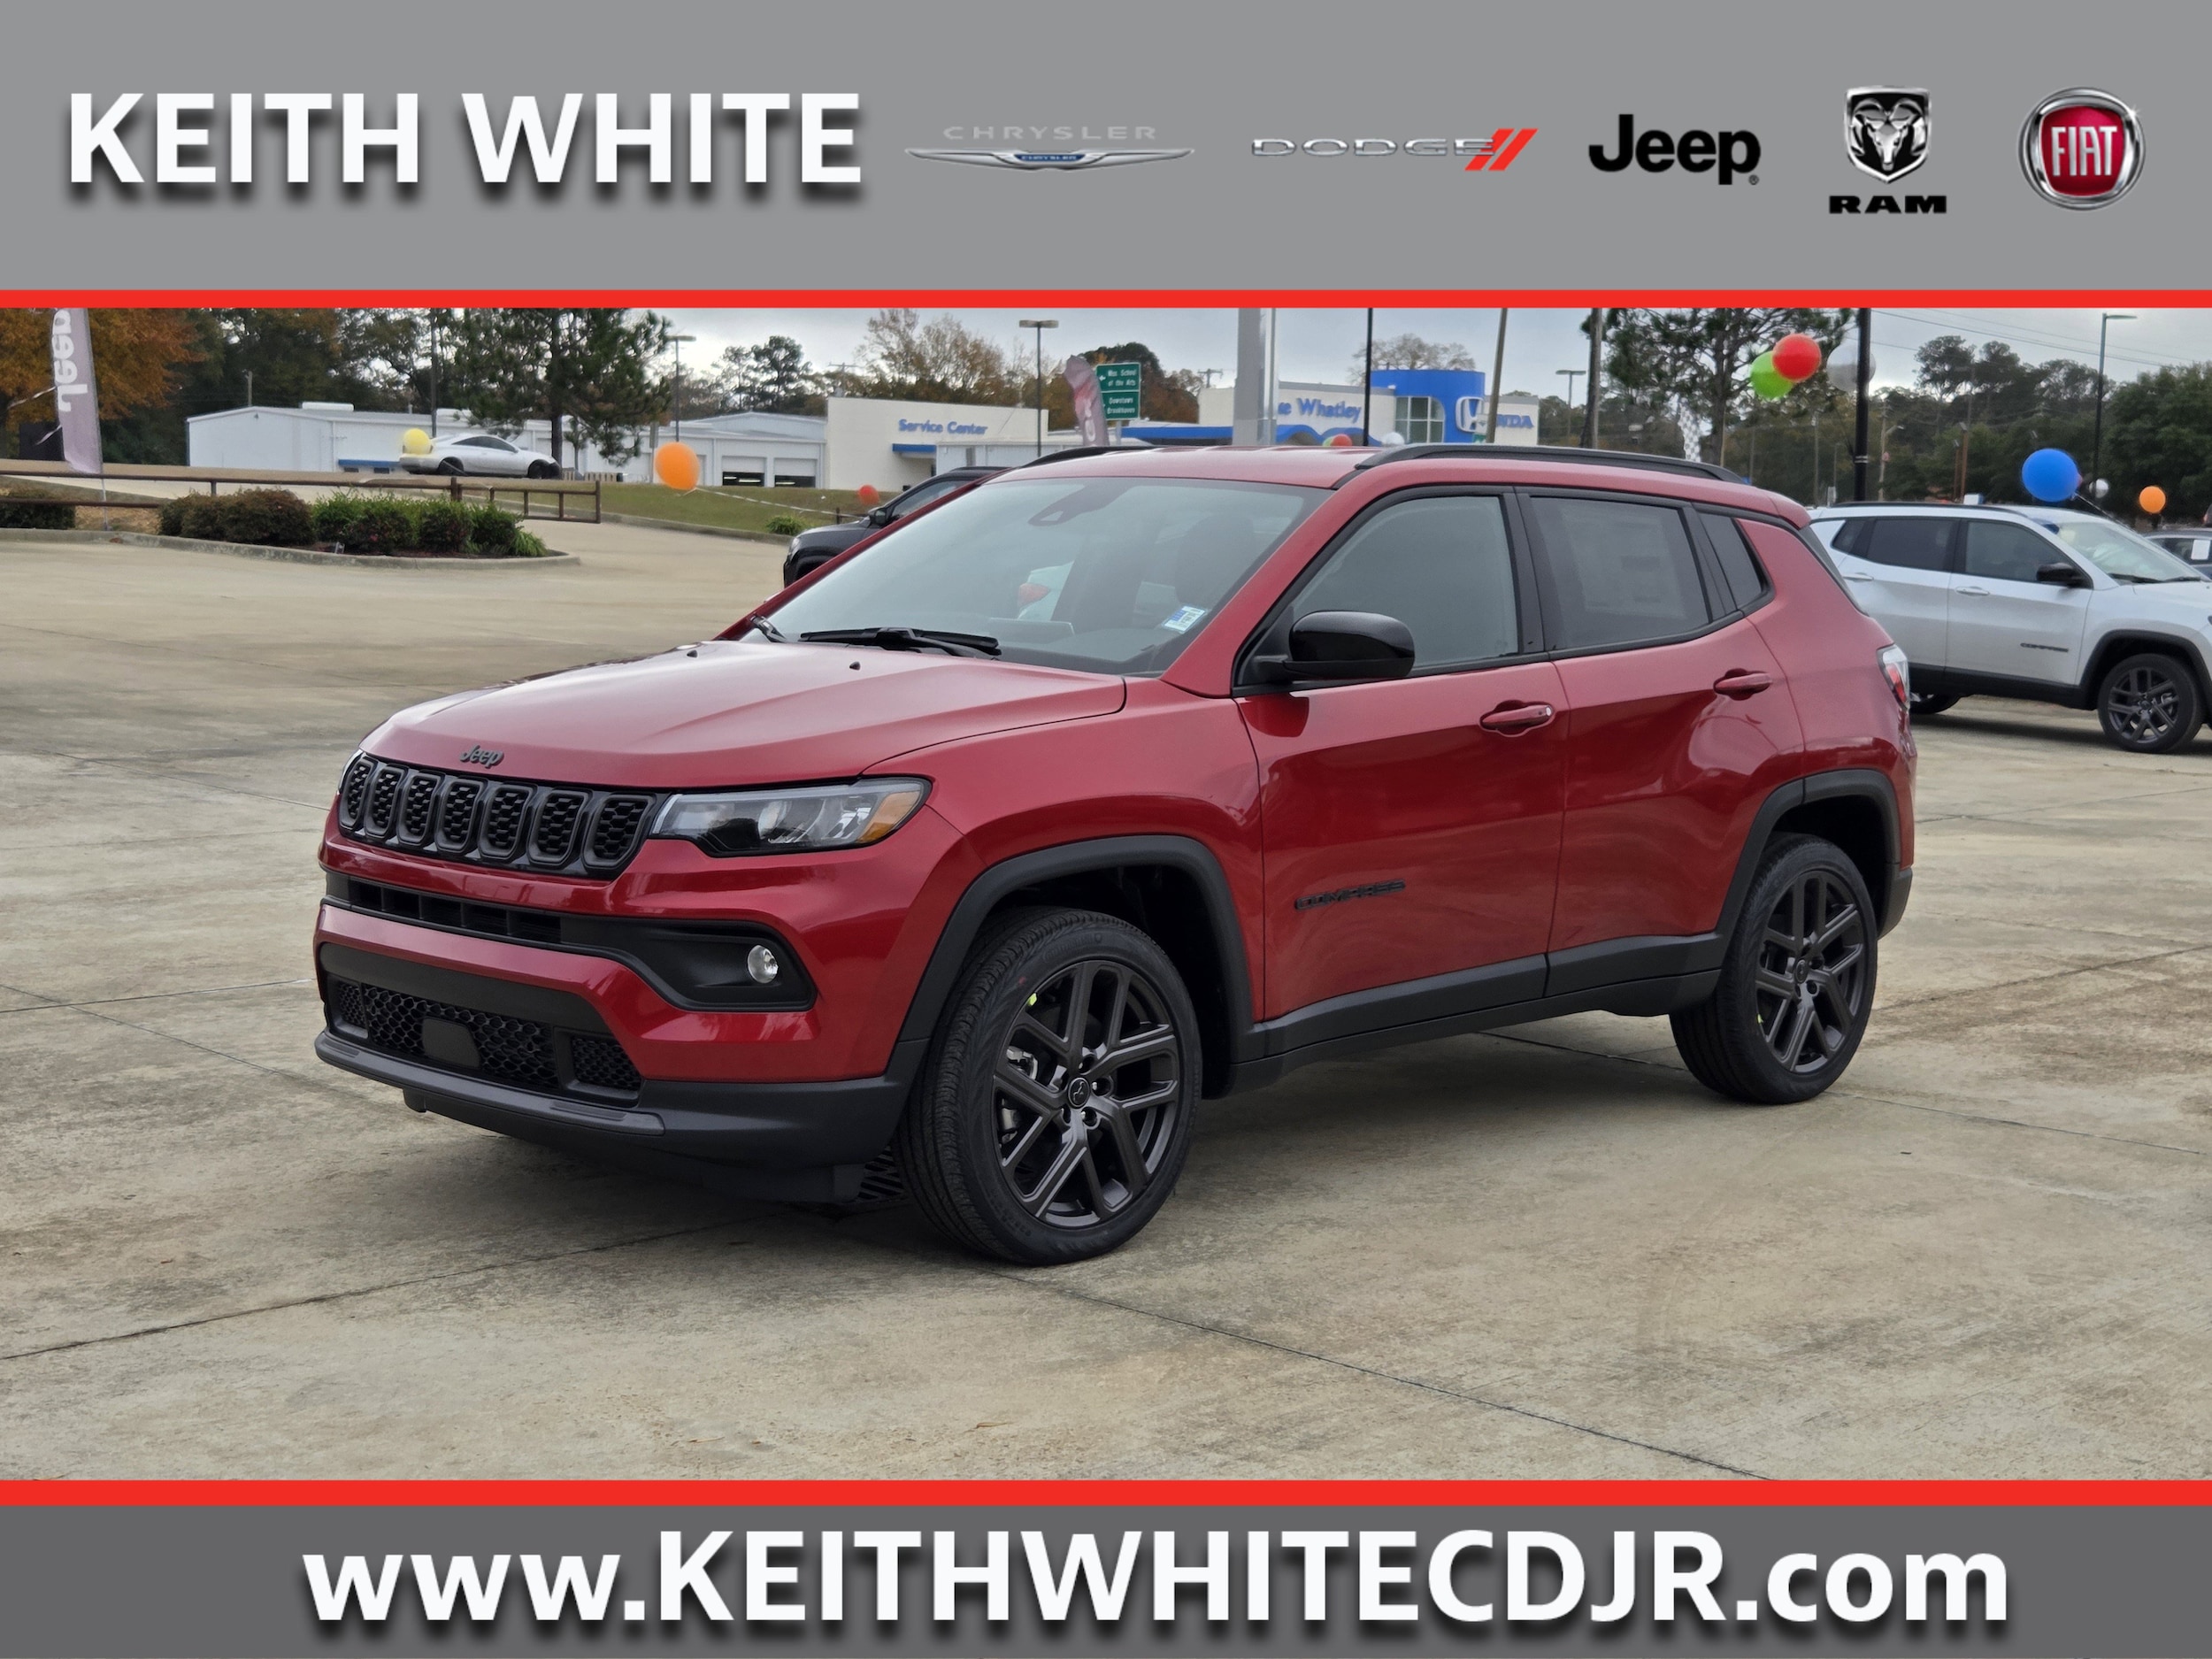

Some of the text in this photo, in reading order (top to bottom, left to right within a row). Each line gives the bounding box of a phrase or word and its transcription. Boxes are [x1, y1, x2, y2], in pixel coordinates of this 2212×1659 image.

[899, 419, 988, 434] Service Center
[460, 743, 504, 769] Jeep
